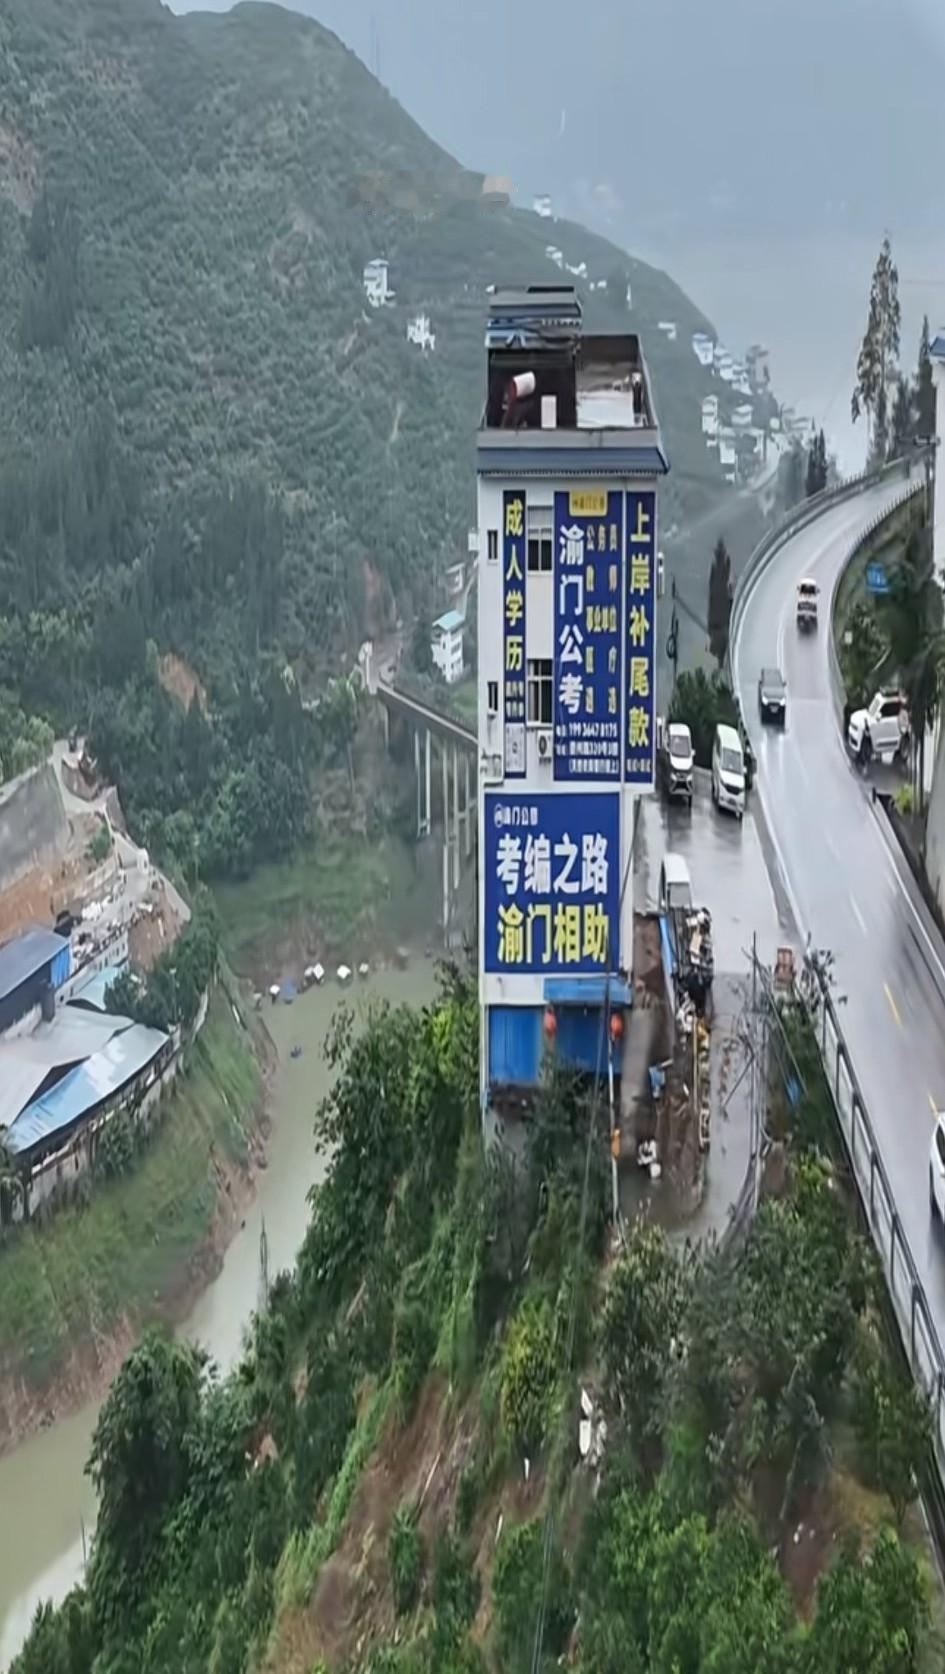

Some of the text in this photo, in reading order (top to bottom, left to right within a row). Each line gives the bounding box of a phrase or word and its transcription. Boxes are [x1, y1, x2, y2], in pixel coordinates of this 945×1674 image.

[505, 499, 524, 672] 成人学历
[558, 523, 584, 715] 渝门公考
[628, 501, 651, 747] 上岸补尾款
[496, 832, 609, 895] 考编之路
[497, 901, 609, 964] 渝门相助
